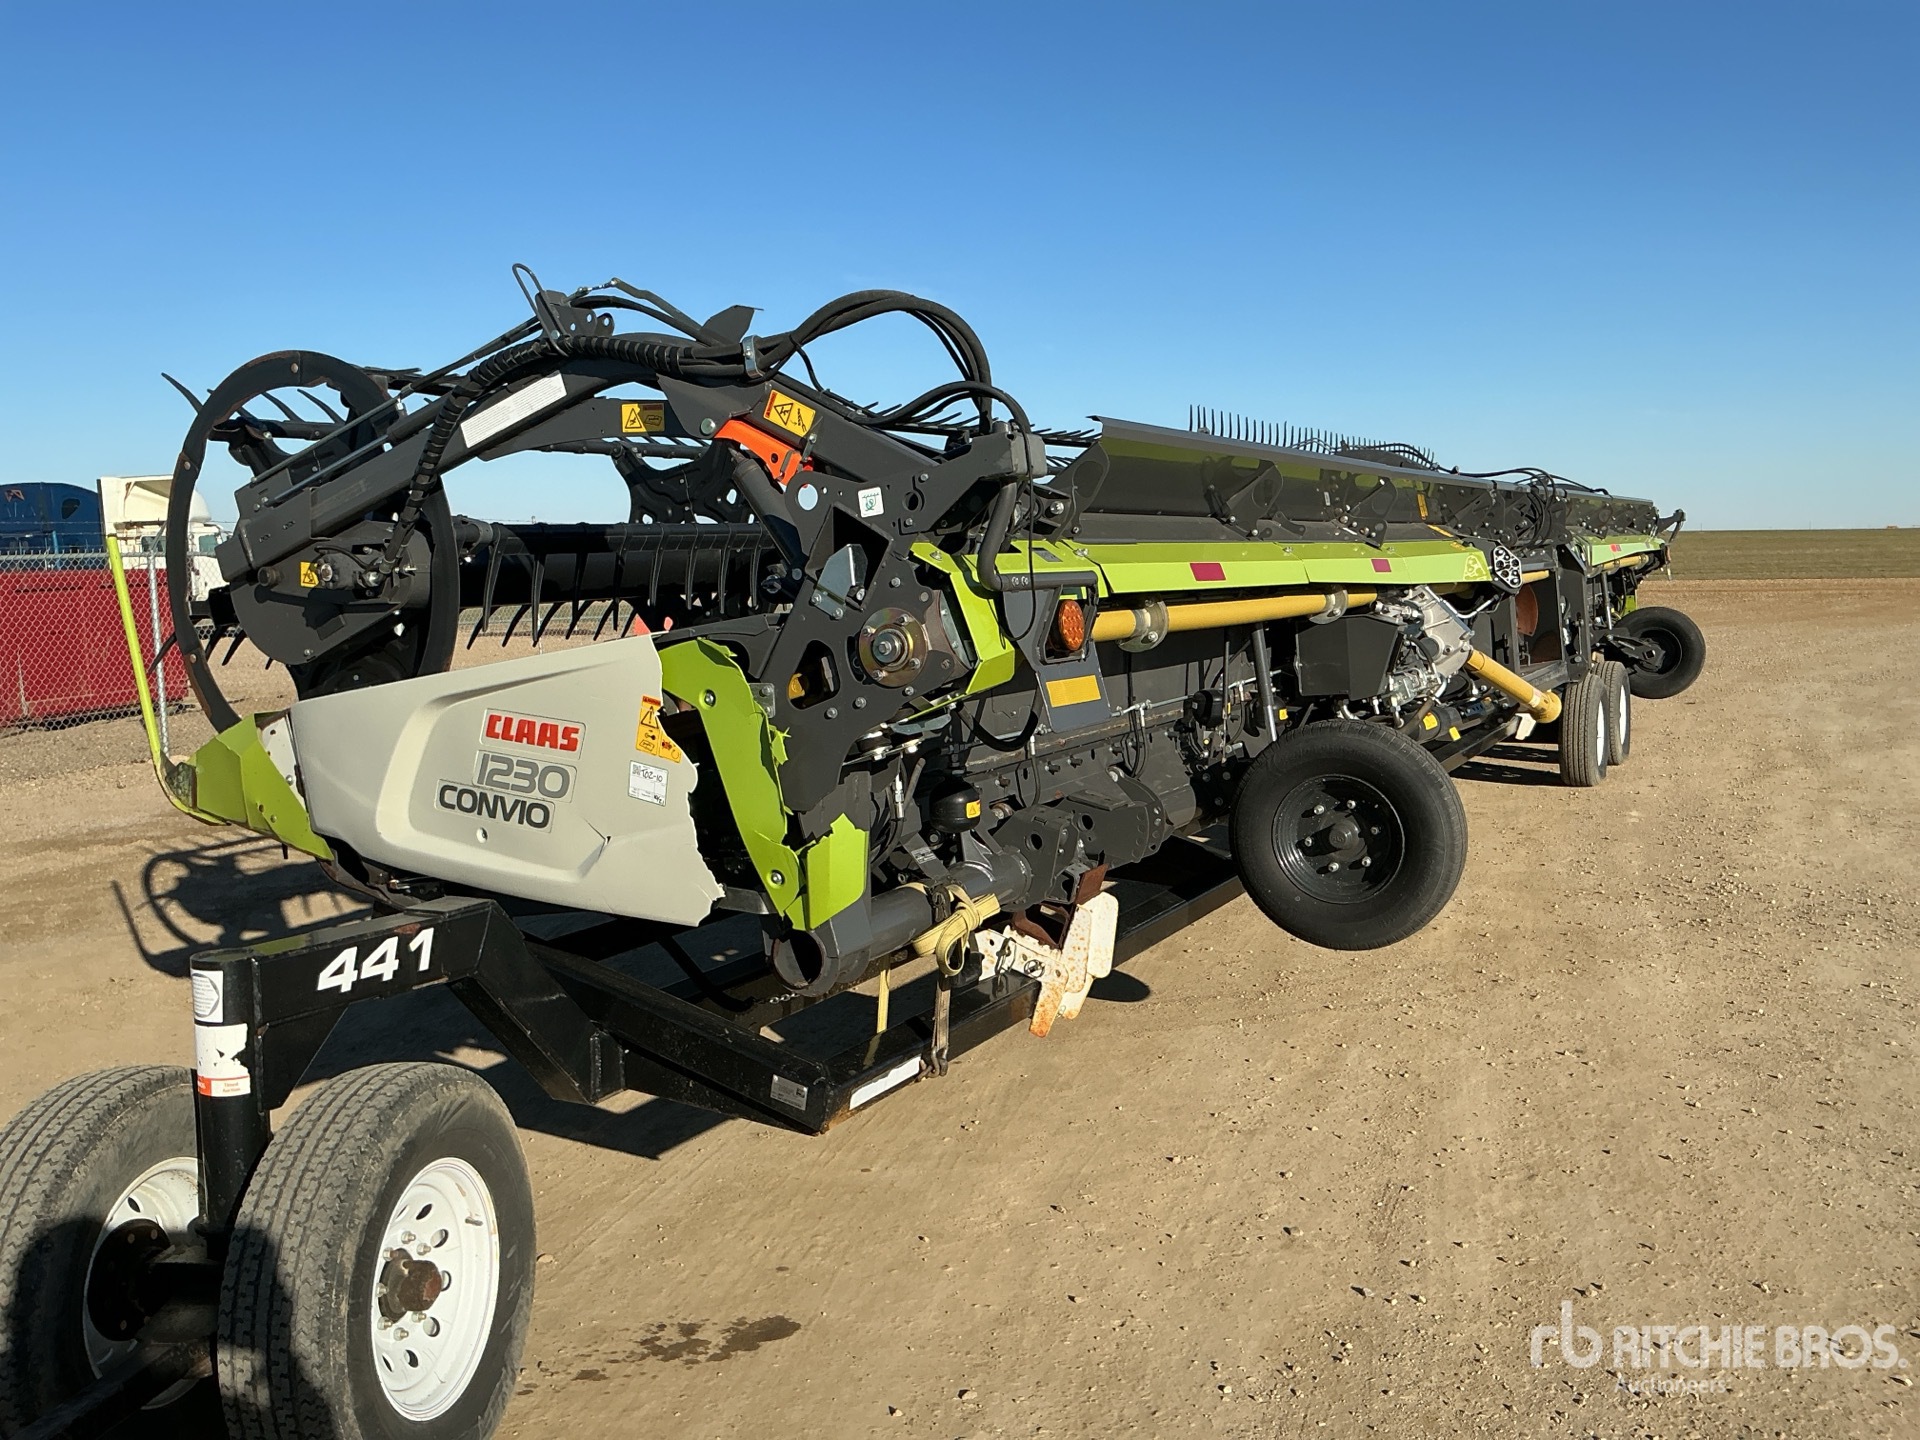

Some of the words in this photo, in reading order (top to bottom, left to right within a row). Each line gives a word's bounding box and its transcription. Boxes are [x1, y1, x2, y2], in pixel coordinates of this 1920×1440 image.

[485, 714, 580, 752] CLAAS
[477, 753, 571, 799] 1230
[439, 785, 551, 829] CONVIO
[317, 927, 435, 993] 441
